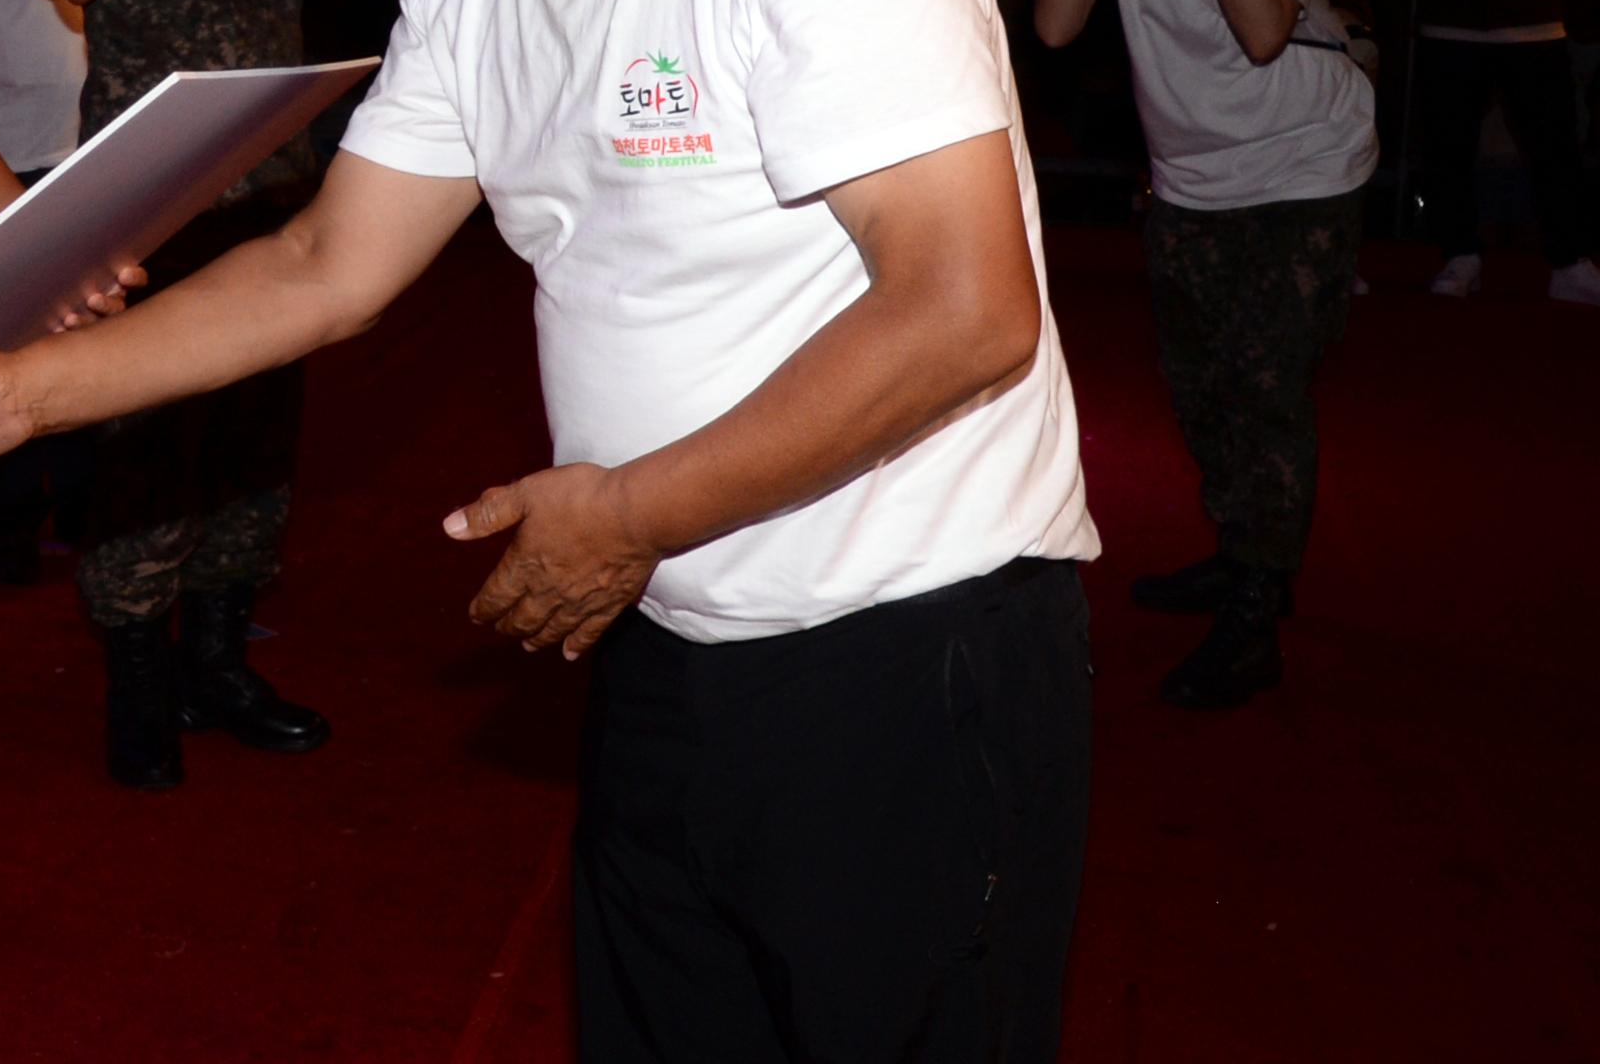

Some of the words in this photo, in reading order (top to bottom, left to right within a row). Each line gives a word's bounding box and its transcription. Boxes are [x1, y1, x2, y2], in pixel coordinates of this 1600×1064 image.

[618, 80, 690, 117] 토마토
[612, 133, 714, 156] 화천토마토축제
[657, 153, 717, 168] FESTIVAL
